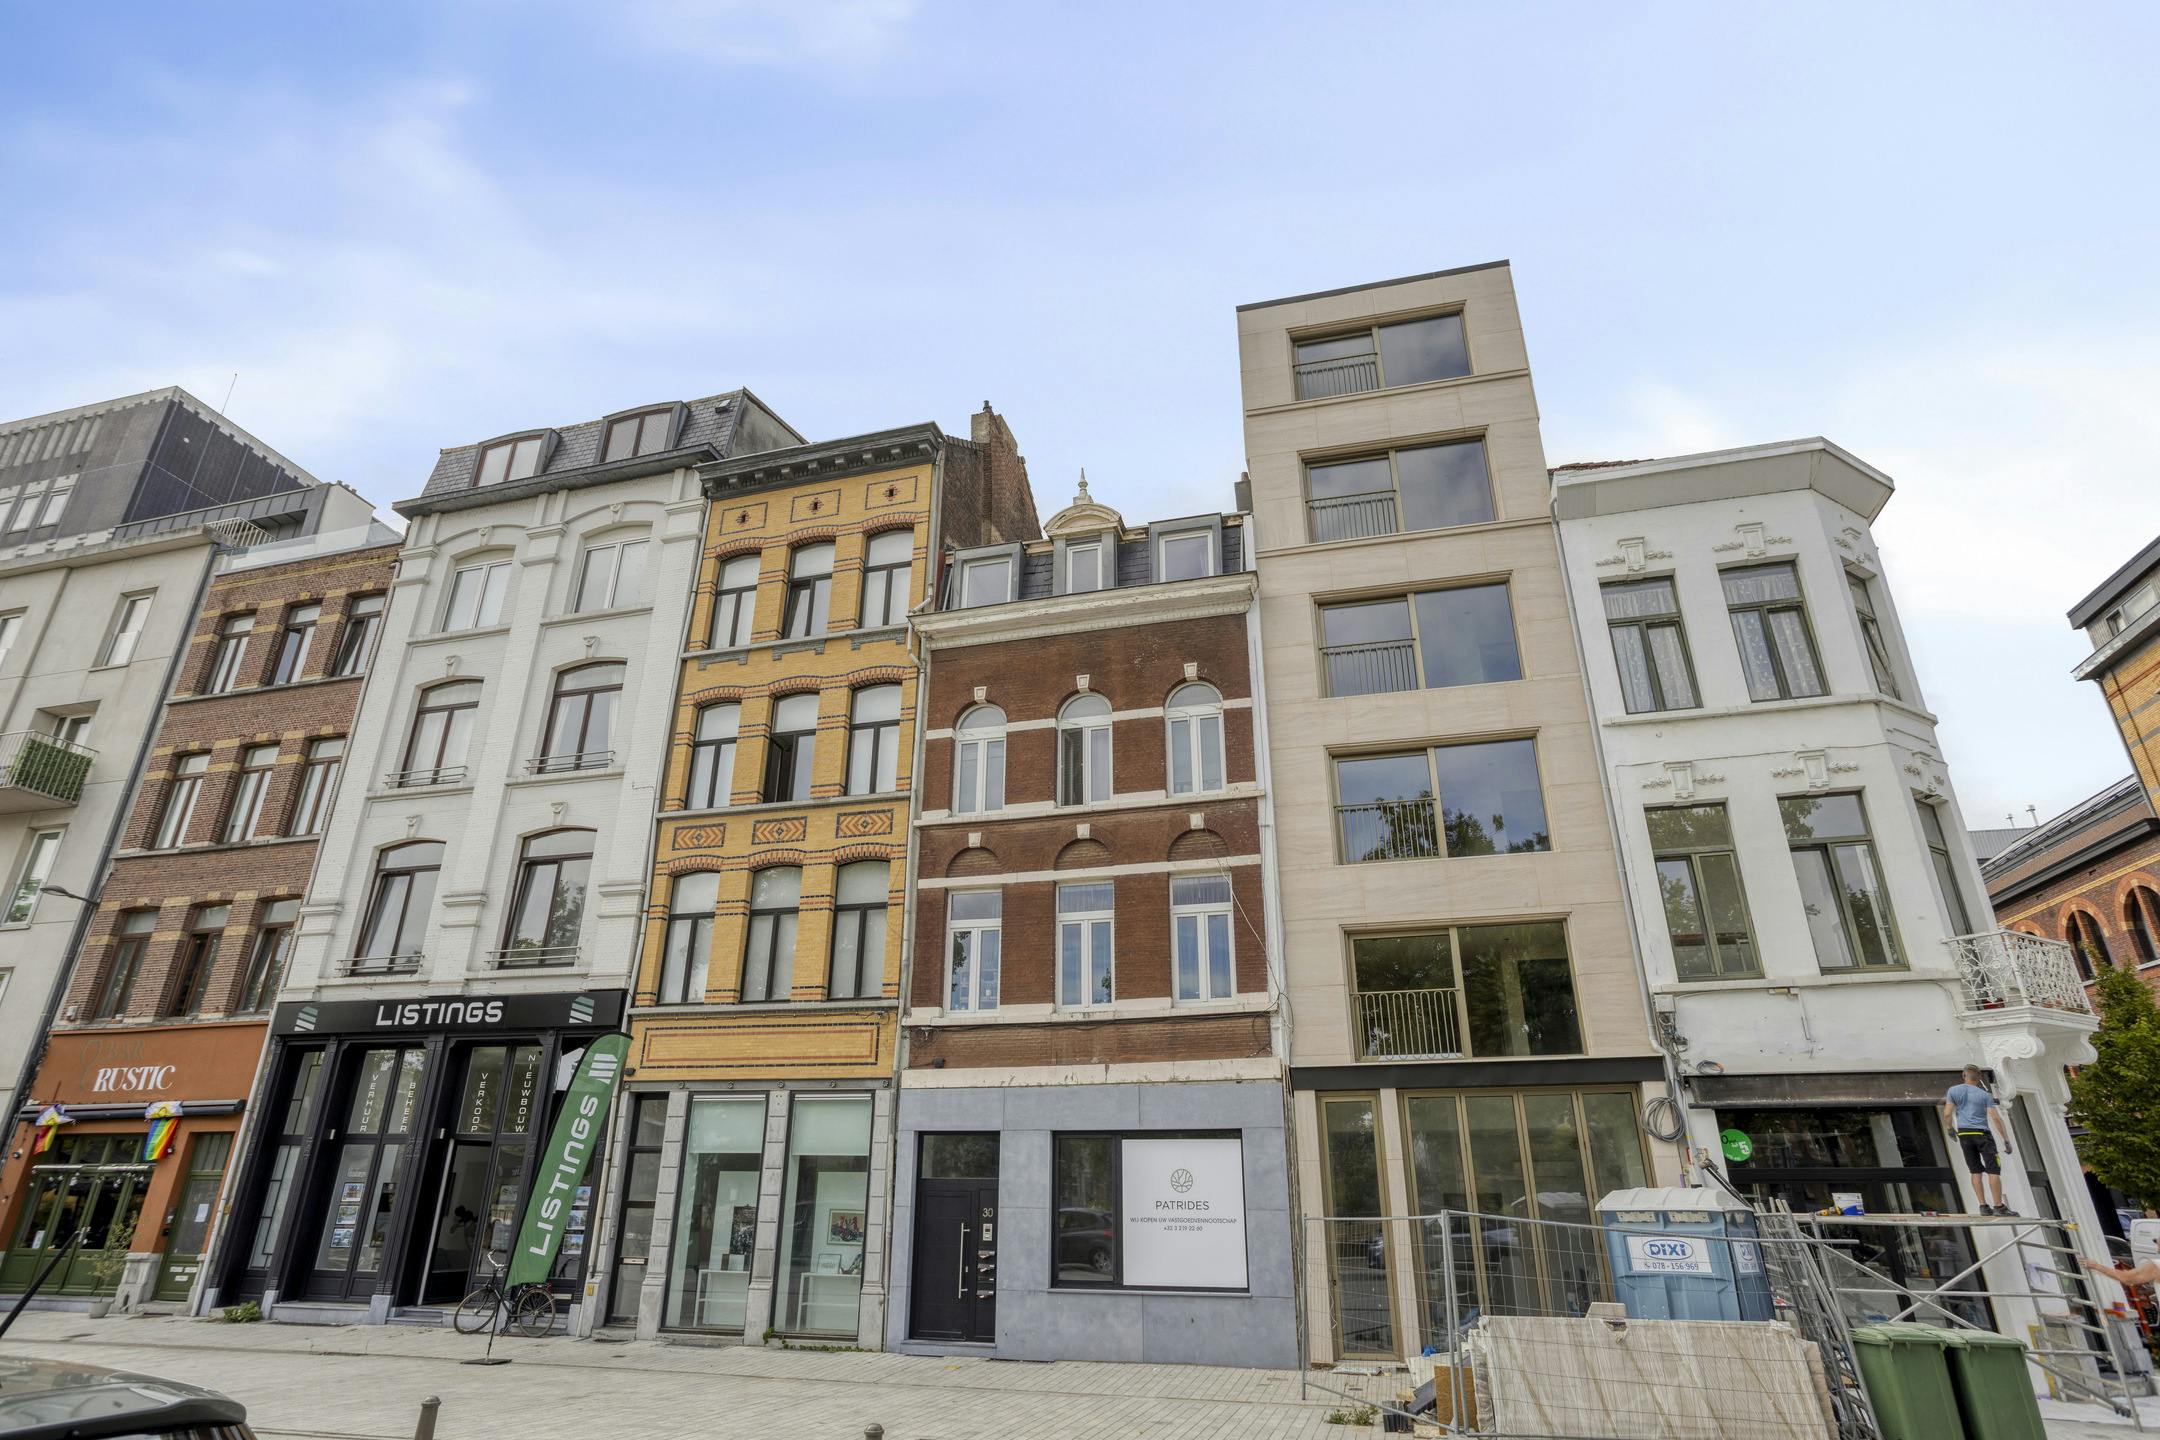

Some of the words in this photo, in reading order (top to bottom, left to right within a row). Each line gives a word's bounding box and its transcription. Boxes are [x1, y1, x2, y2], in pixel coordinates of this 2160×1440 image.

[375, 1001, 504, 1026] LISTINGS
[91, 1065, 176, 1092] RUSTIC
[360, 1074, 379, 1133] VERHUUR
[470, 1073, 489, 1133] VERKOOP
[515, 1054, 536, 1133] NIEUWBOUW
[399, 1082, 416, 1133] BEHEER
[529, 1094, 599, 1257] LISTINGS
[983, 1208, 993, 1217] 30
[1155, 1201, 1209, 1210] PATRIDES
